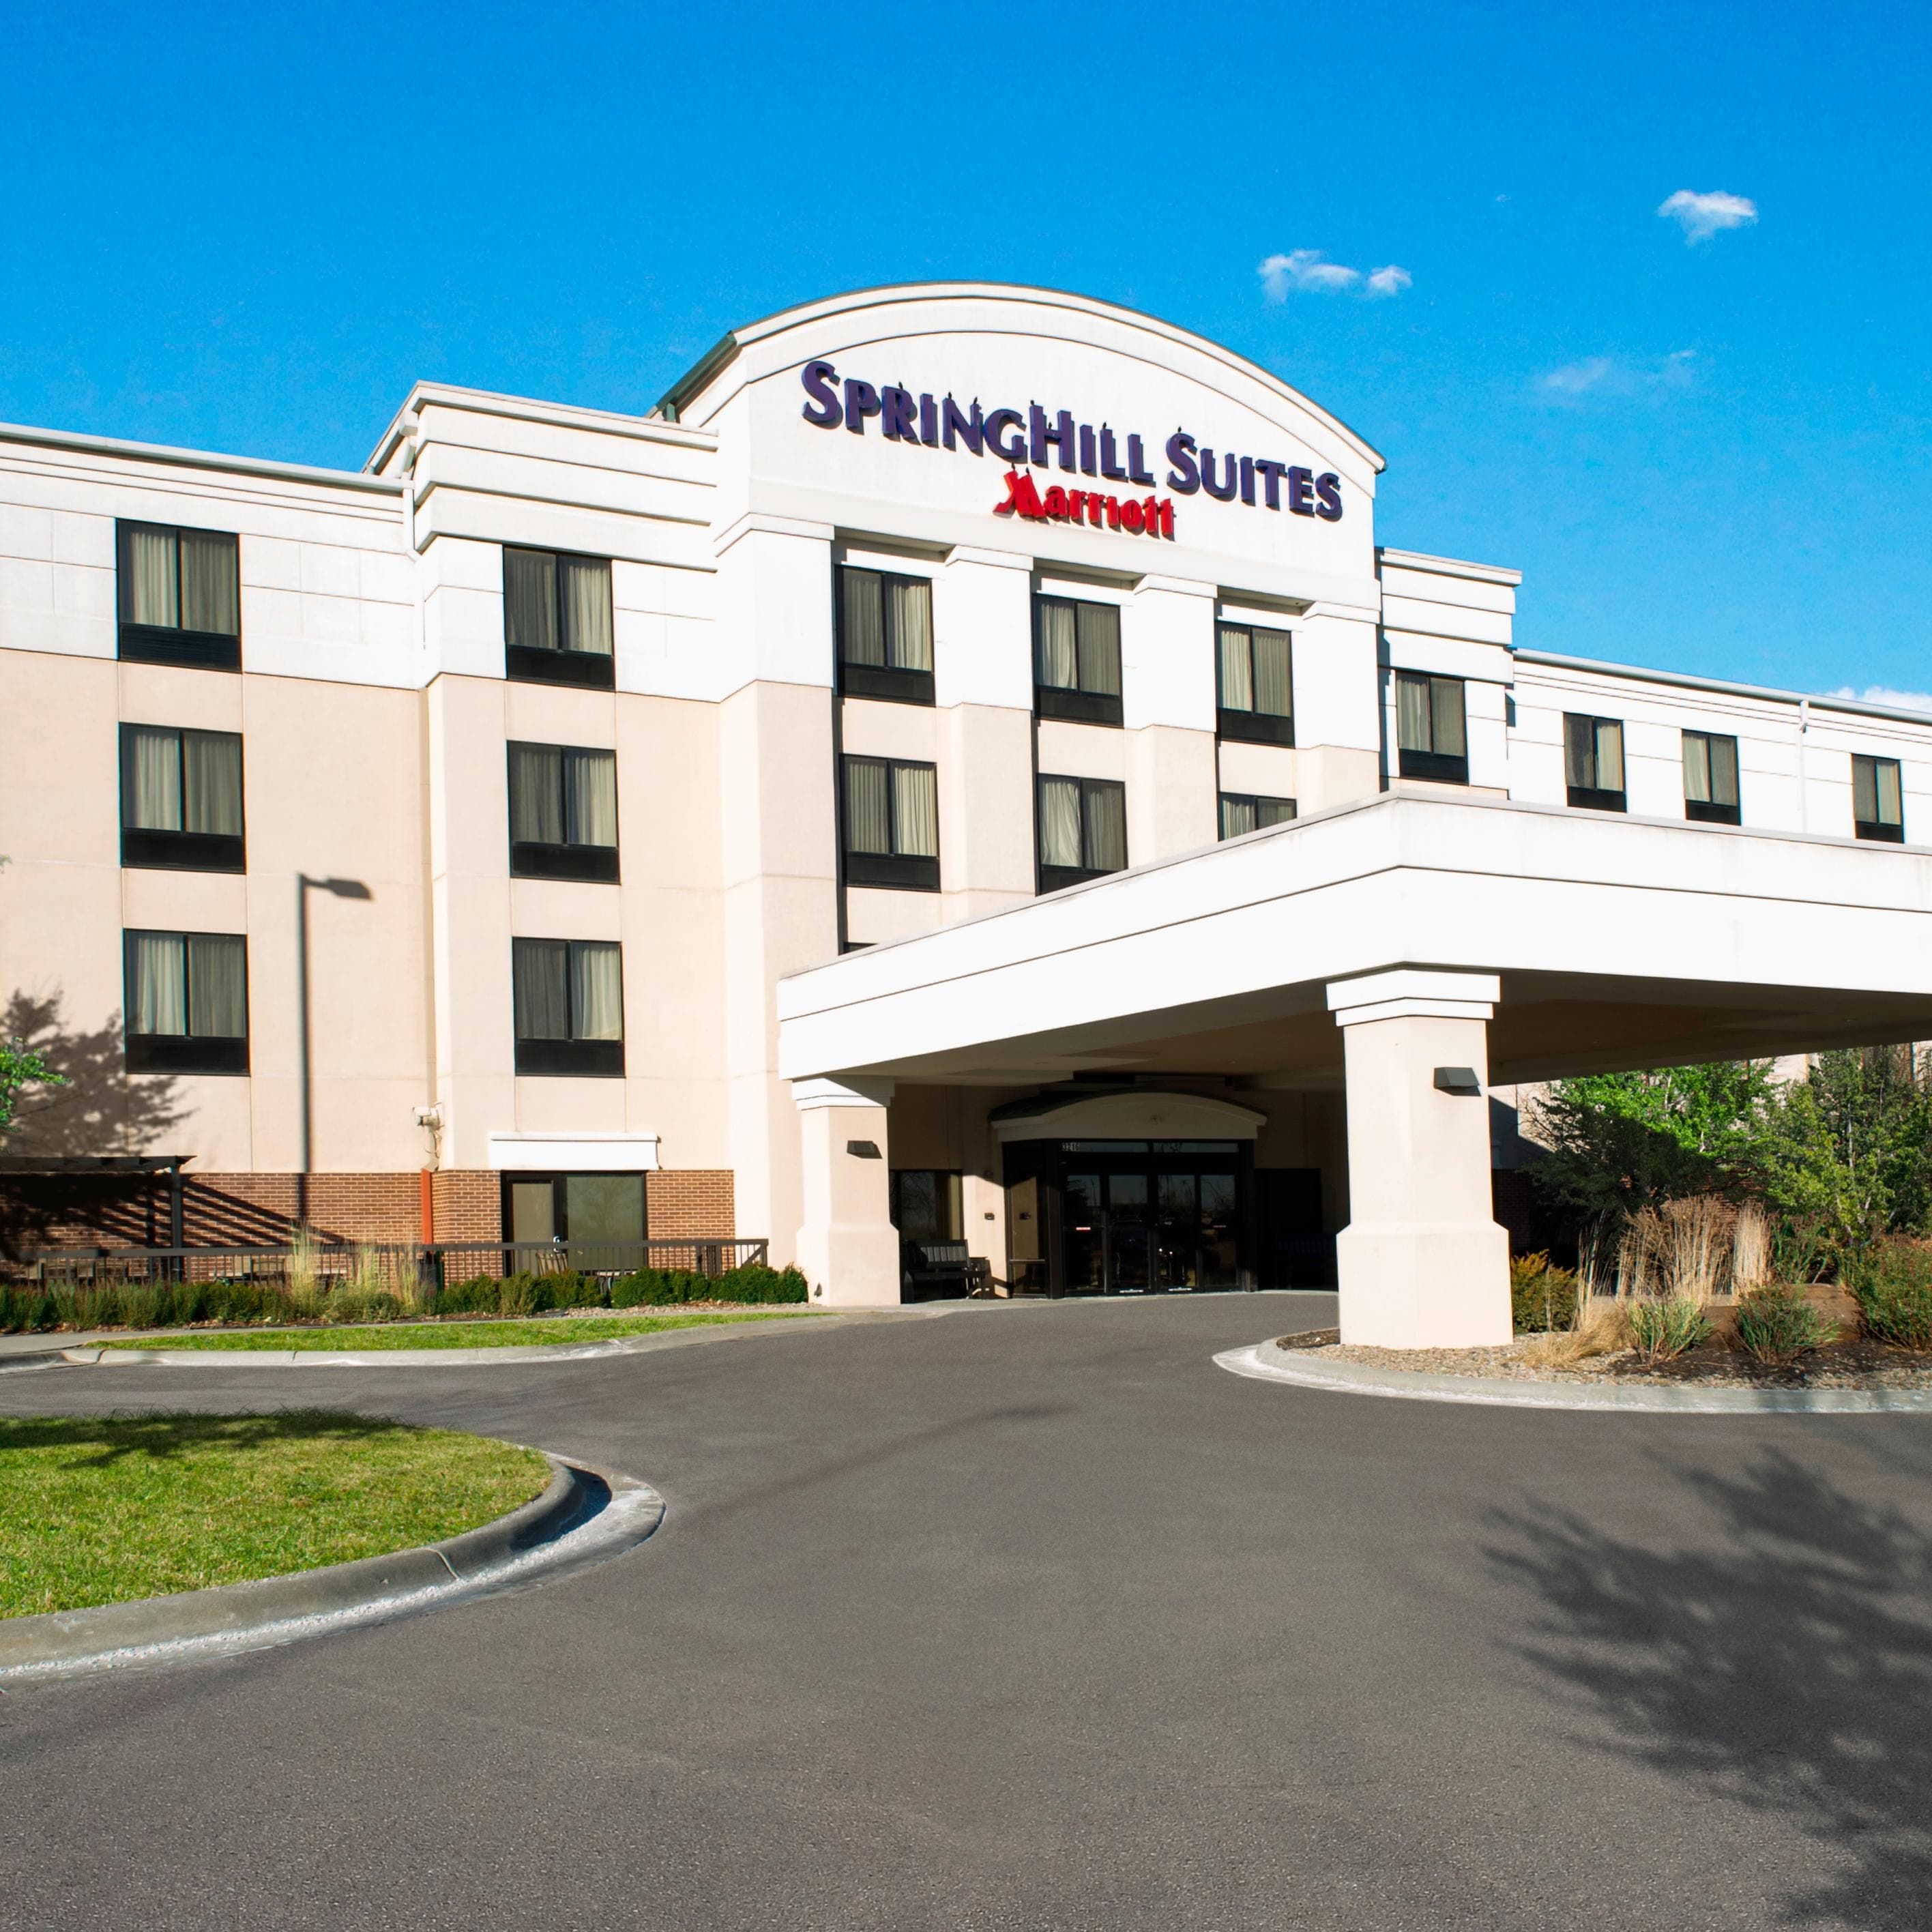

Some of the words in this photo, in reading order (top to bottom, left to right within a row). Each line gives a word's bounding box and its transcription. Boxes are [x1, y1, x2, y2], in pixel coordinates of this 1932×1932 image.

[802, 361, 1155, 484] SPRINGHILL
[1165, 433, 1343, 519] SUITES
[993, 469, 1175, 537] Marriott
